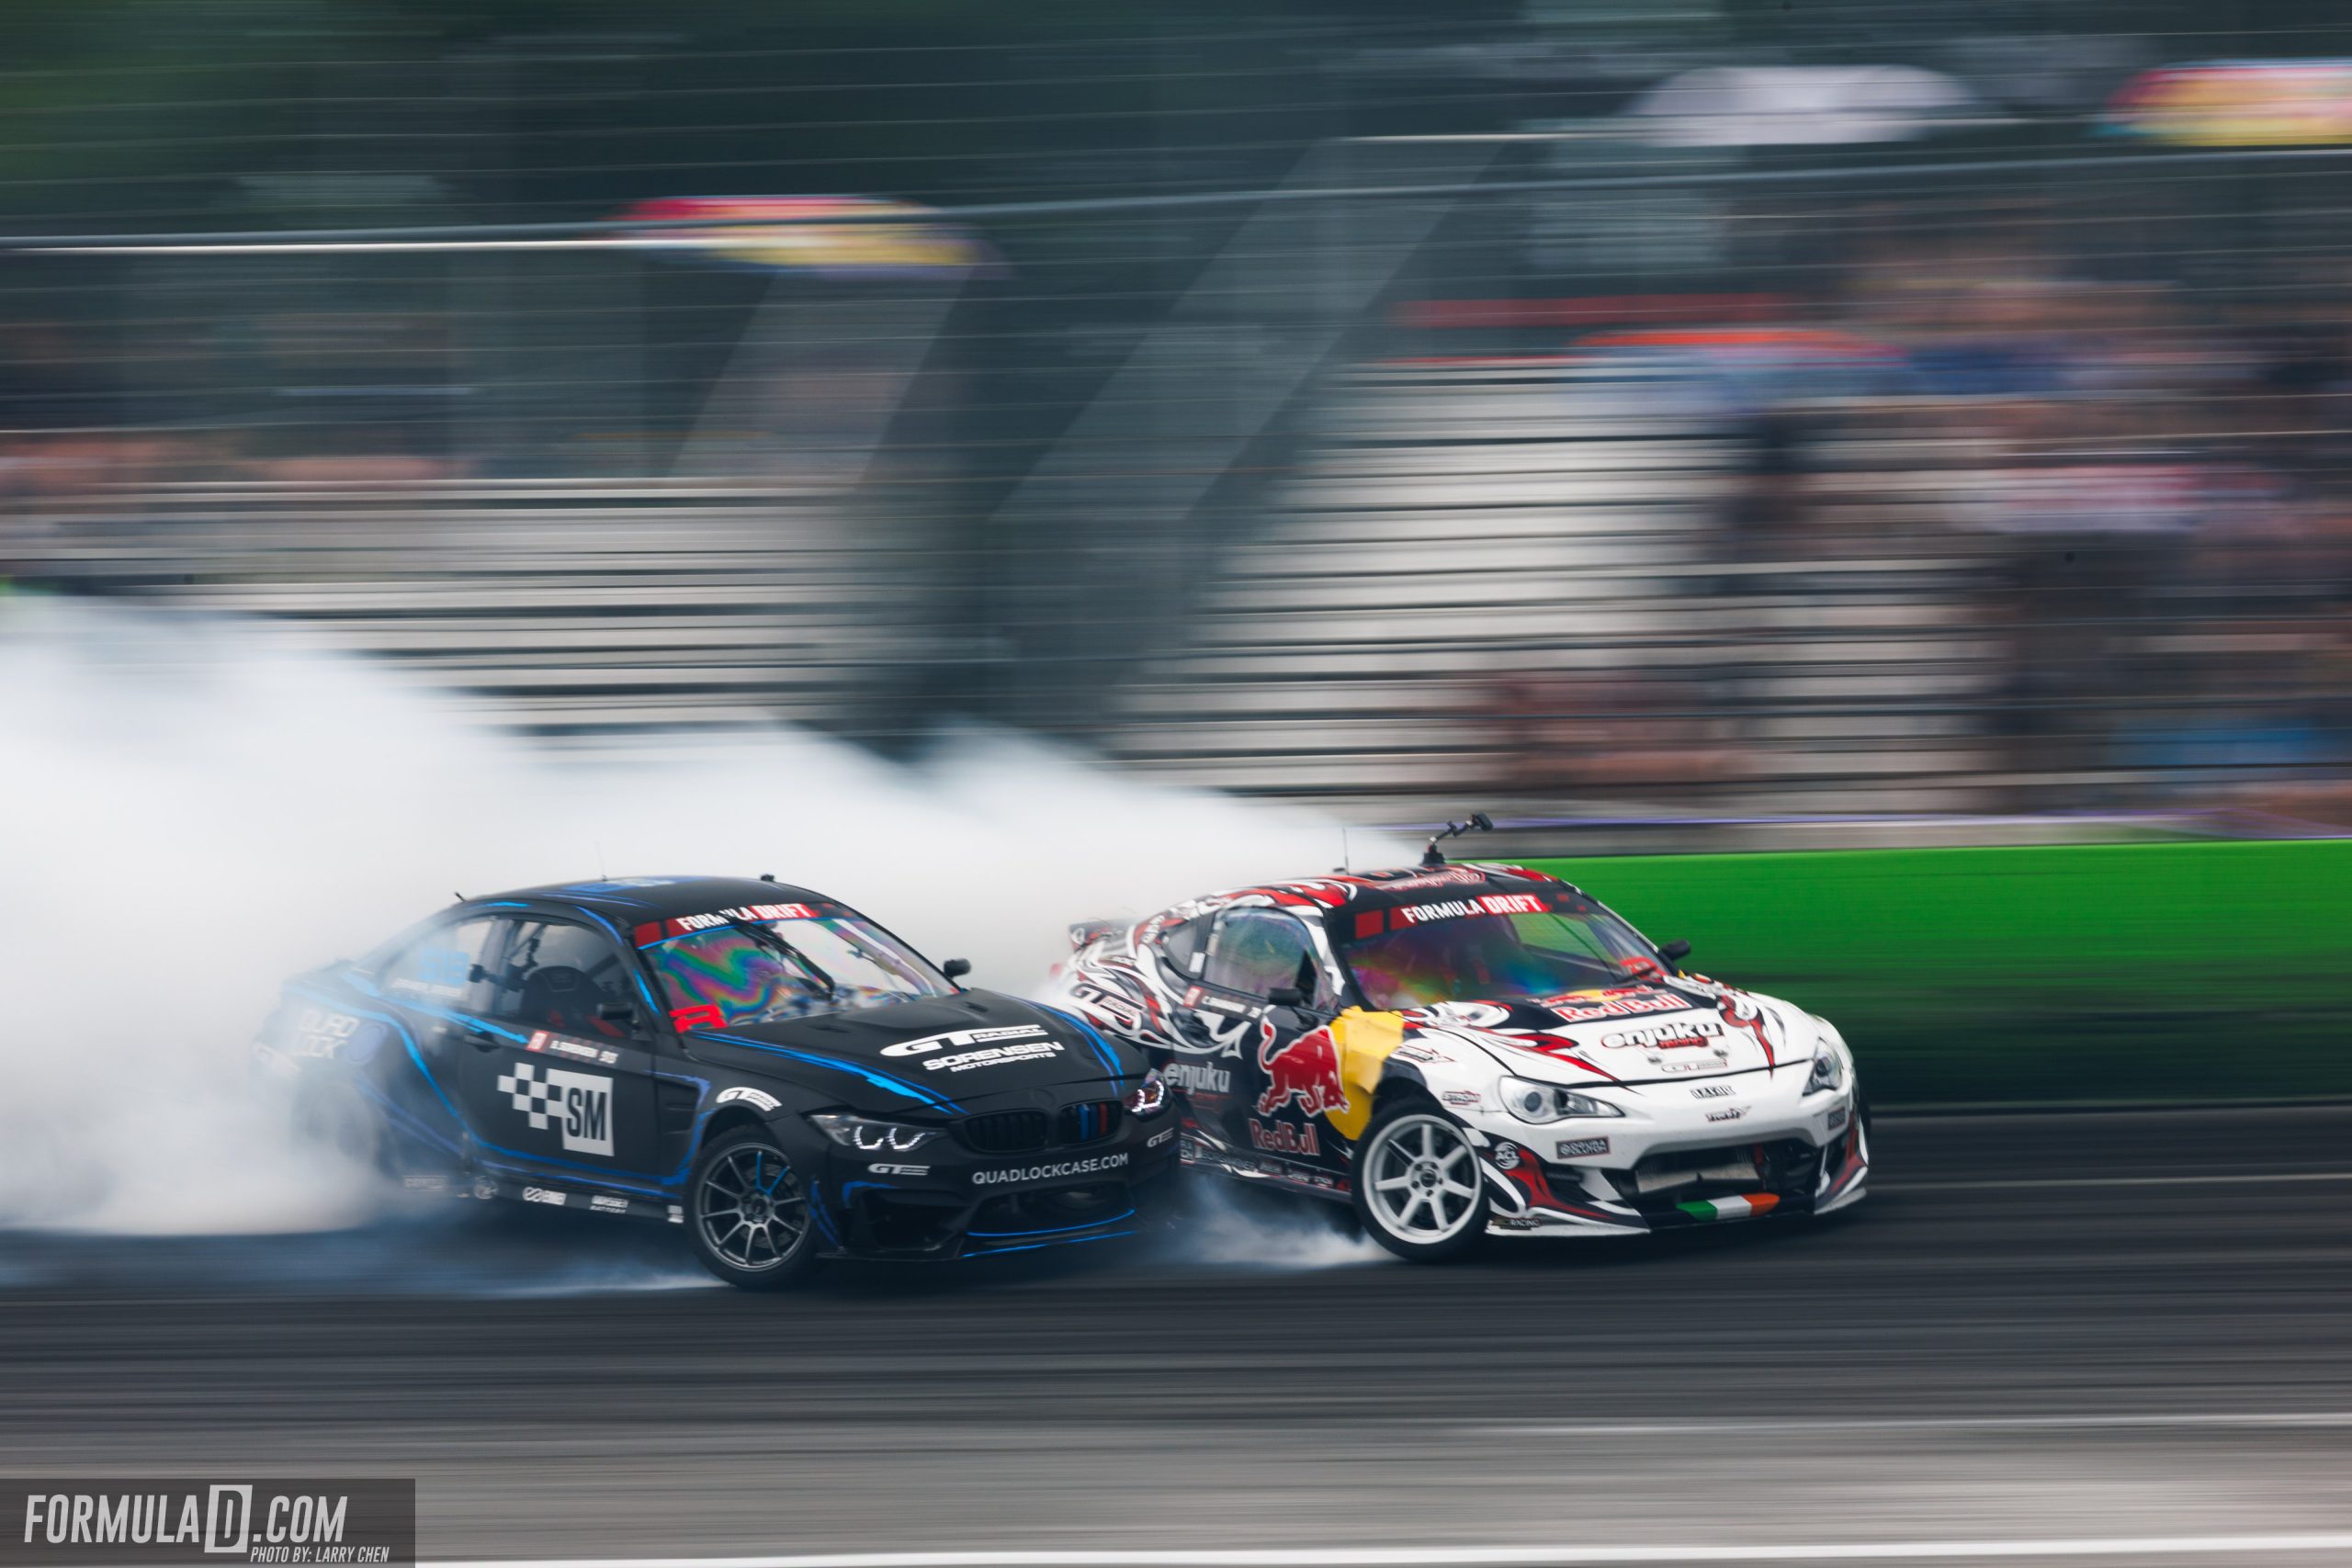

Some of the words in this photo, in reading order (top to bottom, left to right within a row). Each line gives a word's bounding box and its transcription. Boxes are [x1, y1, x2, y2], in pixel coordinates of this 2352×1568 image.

[752, 903, 811, 919] DRIFT
[1401, 898, 1487, 923] FORMULA
[1481, 896, 1544, 914] DRIFT
[973, 1027, 1046, 1041] RADIAL
[1601, 1022, 1724, 1048] enjuku
[922, 1041, 1066, 1071] SORENSEN
[950, 1052, 1057, 1073] MOTORSPORTS
[1162, 1061, 1232, 1095] enjuku
[566, 1087, 607, 1141] SM
[1147, 1128, 1174, 1148] GT
[1494, 1149, 1521, 1161] ACL
[867, 1163, 932, 1177] GT
[972, 1152, 1129, 1185] QUADLOCKCASE.COM
